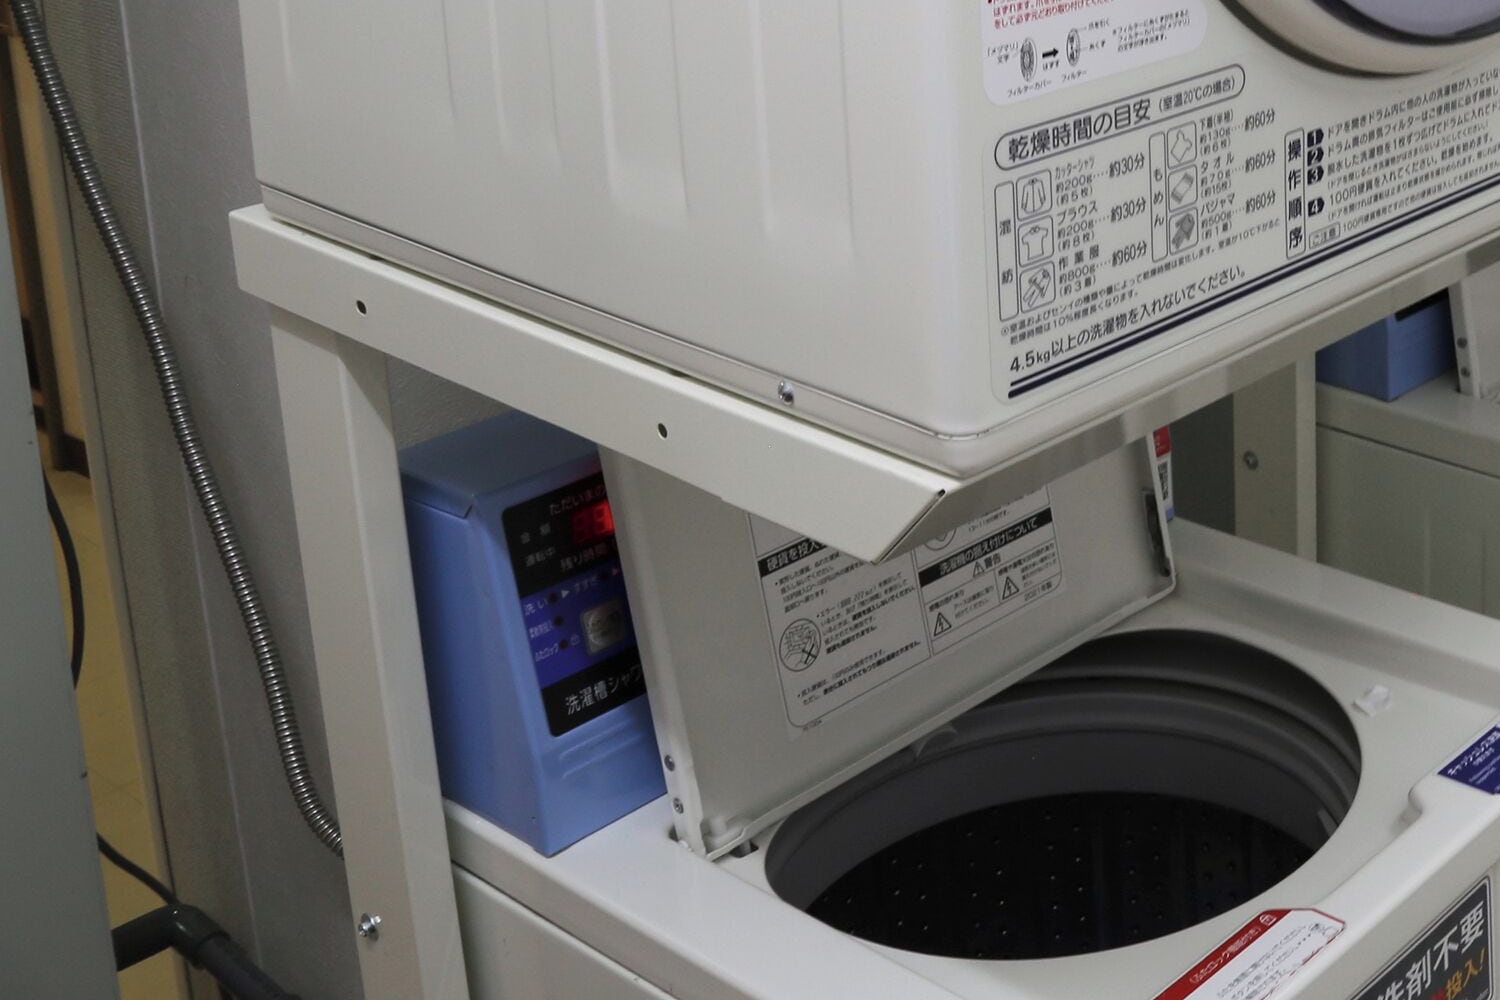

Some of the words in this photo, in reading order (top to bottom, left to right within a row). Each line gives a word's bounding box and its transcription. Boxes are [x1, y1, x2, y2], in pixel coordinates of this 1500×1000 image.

[1008, 99, 1150, 163] 乾燥時間の目安
[1244, 107, 1275, 132] 約60分
[1109, 152, 1145, 179] 約30分
[1245, 149, 1276, 174] 約60分
[1245, 190, 1276, 214] 約60分
[1288, 138, 1303, 250] 操作順序
[1057, 200, 1098, 226] ブラウス
[1111, 196, 1146, 223] 約30分
[1112, 240, 1147, 267] 約60分
